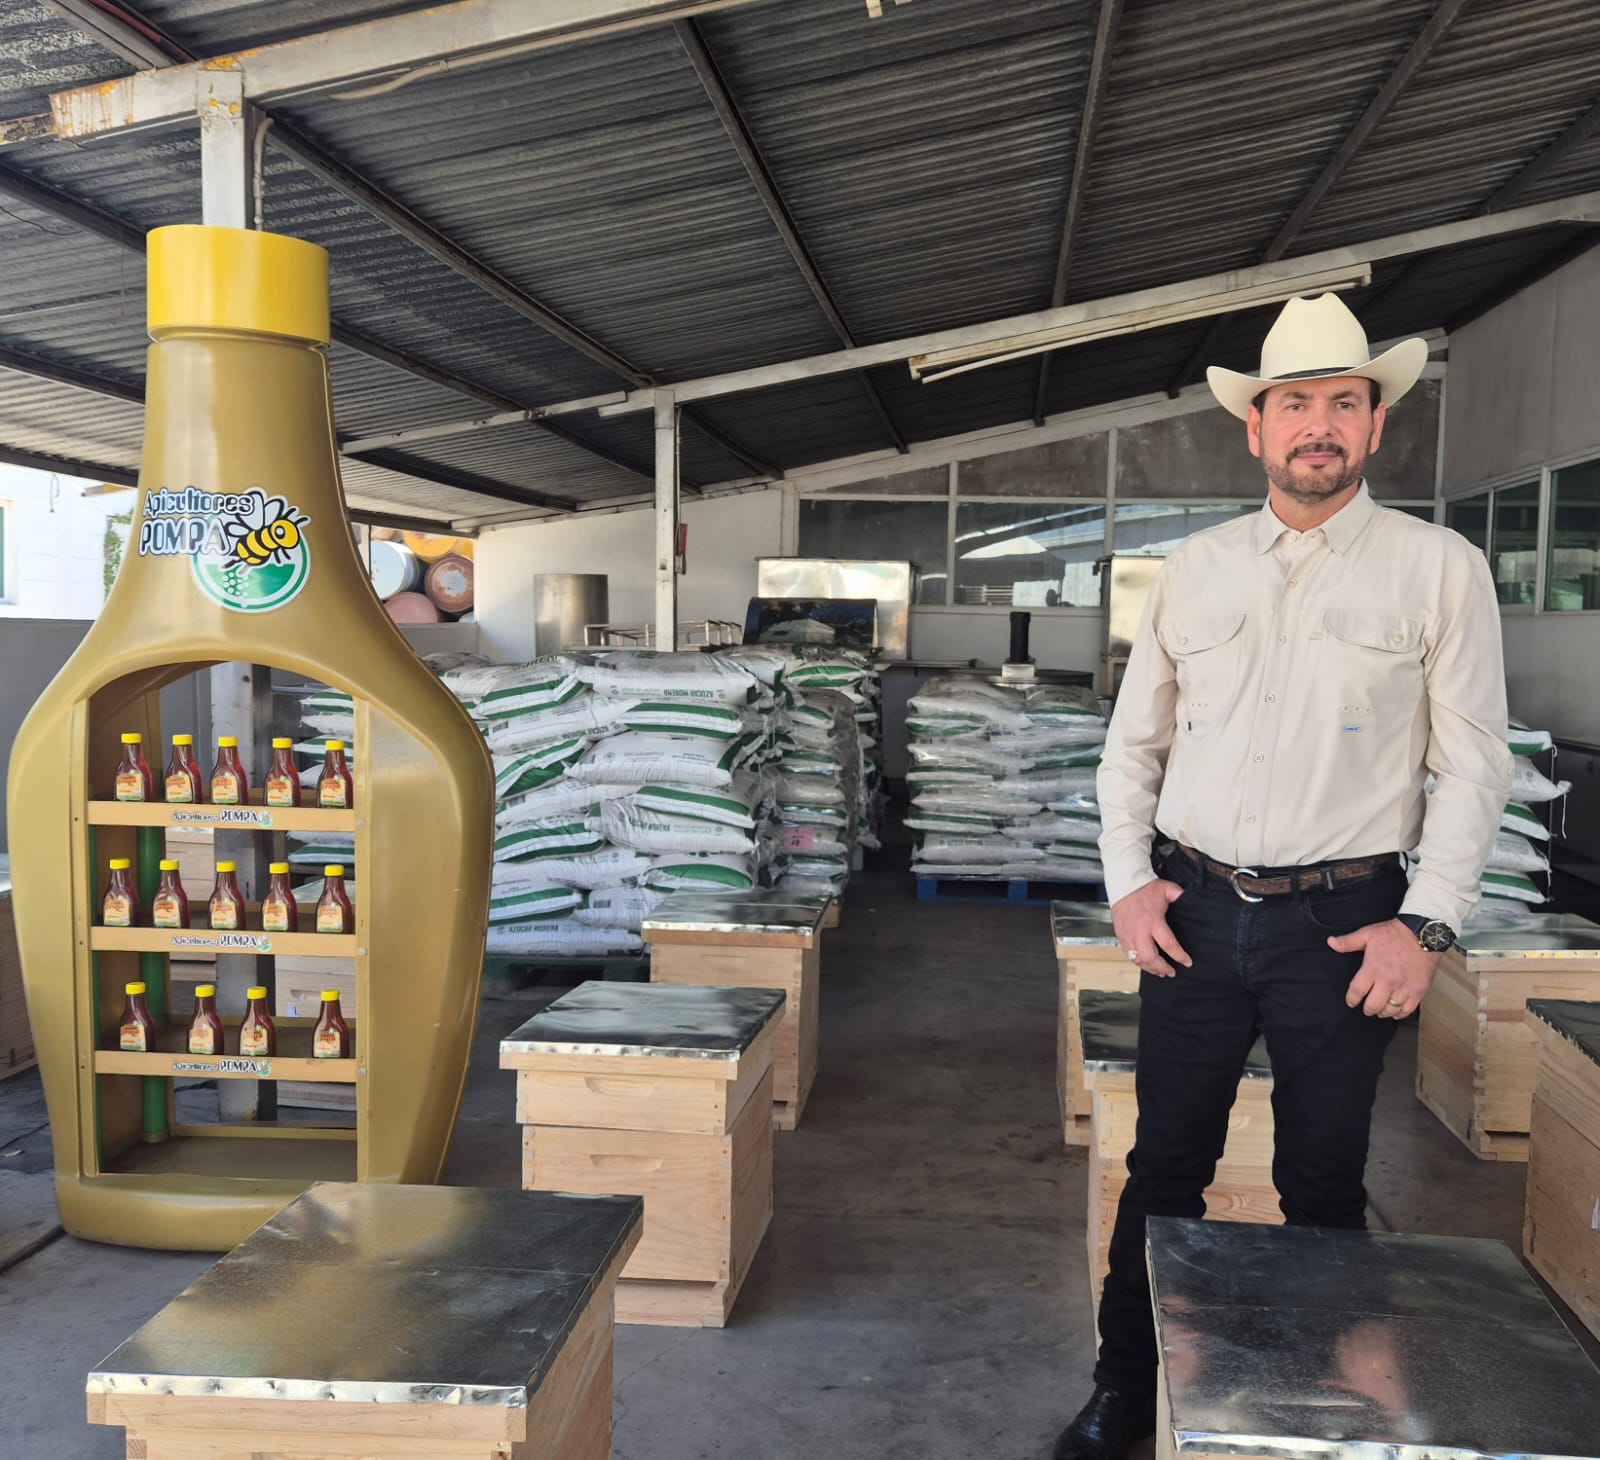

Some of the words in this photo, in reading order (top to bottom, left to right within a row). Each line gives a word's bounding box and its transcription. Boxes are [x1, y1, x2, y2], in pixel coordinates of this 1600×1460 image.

[143, 486, 254, 517] Apicultores
[140, 517, 230, 556] POMPA
[219, 809, 258, 822] POMPA
[219, 934, 257, 947] POMPA
[219, 1059, 257, 1072] POMPA
